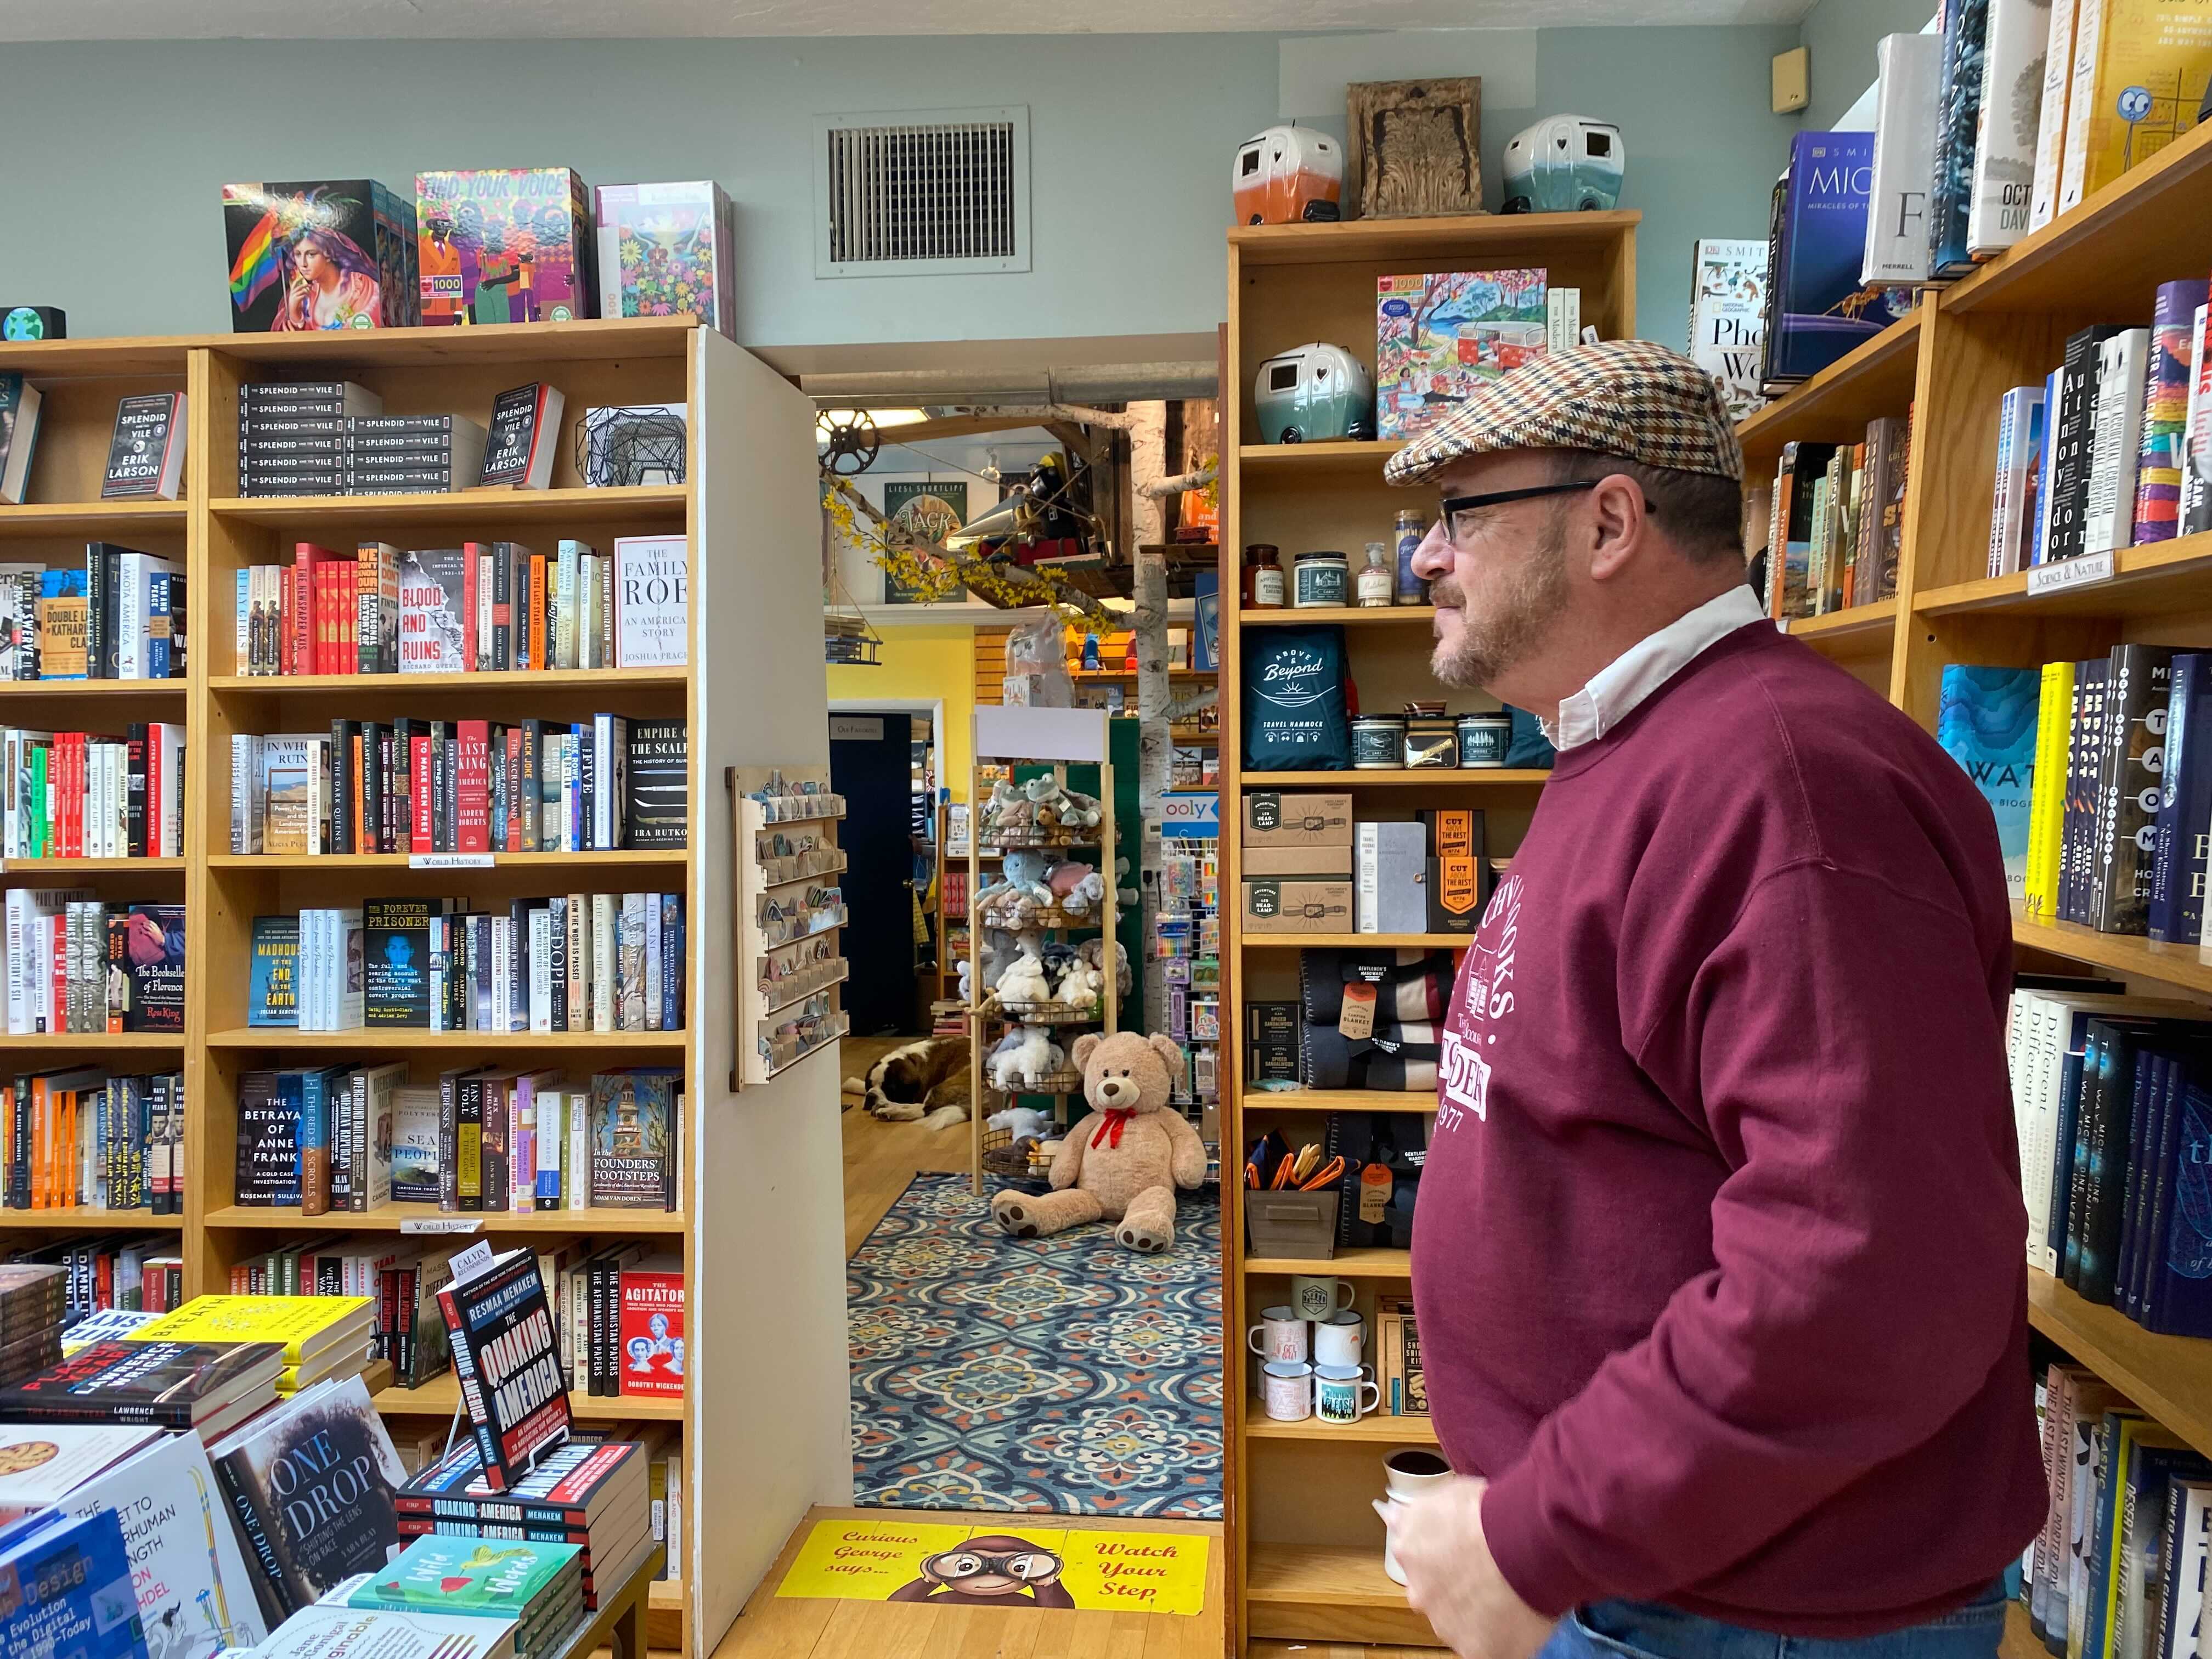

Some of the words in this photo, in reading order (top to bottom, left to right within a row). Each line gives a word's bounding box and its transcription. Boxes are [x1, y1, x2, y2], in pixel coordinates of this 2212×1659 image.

[435, 278, 460, 289] 1000
[1395, 278, 1423, 289] 1000
[608, 294, 617, 315] 500
[2149, 328, 2163, 373] SUPER
[121, 414, 166, 424] SPLENDID
[496, 404, 532, 420] SPLENDID
[2141, 375, 2160, 457] VOLCANOES
[505, 421, 521, 431] VILE
[122, 454, 149, 465] ERIK
[496, 447, 518, 460] ERIK
[109, 466, 159, 478] LARSON
[485, 456, 526, 473] LARSON
[900, 510, 952, 531] JACK
[358, 549, 377, 561] WE
[625, 562, 687, 577] FAMILY
[2064, 566, 2071, 583] &
[2075, 560, 2104, 579] NATURE
[358, 578, 377, 587] OUR
[624, 578, 687, 605] ROE
[403, 588, 441, 607] BLOOD
[47, 611, 77, 622] DOUBLE
[403, 614, 425, 633] AND
[642, 629, 675, 637] STORY
[403, 641, 441, 660] RUINS
[625, 653, 657, 661] JOSHUA
[1275, 649, 1312, 661] ABOVE
[1263, 658, 1324, 682] Beyond
[637, 727, 677, 739] EMPIRE
[2090, 682, 2104, 778] IMPACT
[421, 742, 427, 753] TO
[459, 743, 486, 755] LAST
[631, 744, 651, 754] THE
[459, 758, 486, 769] KING
[1166, 800, 1206, 819] ooly
[2103, 786, 2118, 865] MICHAEL
[383, 905, 427, 913] FOREVER
[369, 917, 429, 927] PRISONER
[136, 965, 149, 977] The
[551, 936, 564, 989] DOPE
[273, 969, 290, 980] END
[144, 985, 150, 993] of
[153, 981, 183, 991] Florence
[267, 993, 295, 1006] EARTH
[1343, 1017, 1369, 1026] BLANKET
[2039, 1016, 2057, 1115] Different
[353, 1077, 364, 1121] OVERGROUND
[245, 1111, 301, 1120] BETRAYA
[268, 1125, 284, 1134] OF
[353, 1122, 364, 1152] RAILROAD
[258, 1139, 294, 1148] ANNE
[408, 1135, 435, 1145] SEA
[253, 1153, 297, 1162] FRANK
[594, 1171, 659, 1182] FOOTSTEPS
[458, 1249, 486, 1269] CALVIN
[458, 1256, 490, 1277] RECOMMENDS
[469, 1296, 503, 1322] RESMAA
[503, 1273, 538, 1306] MENAKEM
[151, 1299, 232, 1337] BREATH
[479, 1310, 552, 1387] QUAKING
[75, 1342, 176, 1395] LAWRENCE
[108, 1347, 181, 1387] WRIGHT
[494, 1353, 562, 1432] AMERICA
[1325, 1399, 1352, 1410] PLEASE
[2063, 1395, 2072, 1420] THE
[2059, 1424, 2070, 1455] LAST
[270, 1429, 341, 1496] ONE
[2098, 1423, 2111, 1490] PLASTIC
[2056, 1458, 2068, 1502] WINTER
[284, 1455, 374, 1542] DROP
[2169, 1488, 2177, 1511] HOW
[434, 1500, 476, 1517] QUAKING
[481, 1504, 521, 1521] AMERICA
[527, 1511, 561, 1521] MENAKEM
[2122, 1481, 2136, 1541] DESERT
[2167, 1513, 2176, 1533] TO
[236, 1494, 260, 1533] ONE
[253, 1533, 283, 1579] DROP
[843, 1531, 918, 1544] Curious
[2051, 1513, 2063, 1559] PORTER
[834, 1545, 902, 1560] George
[1095, 1542, 1178, 1559] Watch
[2163, 1534, 2175, 1573] AVOID
[406, 1553, 456, 1583] Wild
[485, 1555, 538, 1594] Words
[824, 1562, 889, 1575] says...
[1099, 1561, 1168, 1578] Your
[2049, 1561, 2059, 1589] FOX
[2117, 1544, 2131, 1598] WATER
[1098, 1581, 1157, 1600] Step
